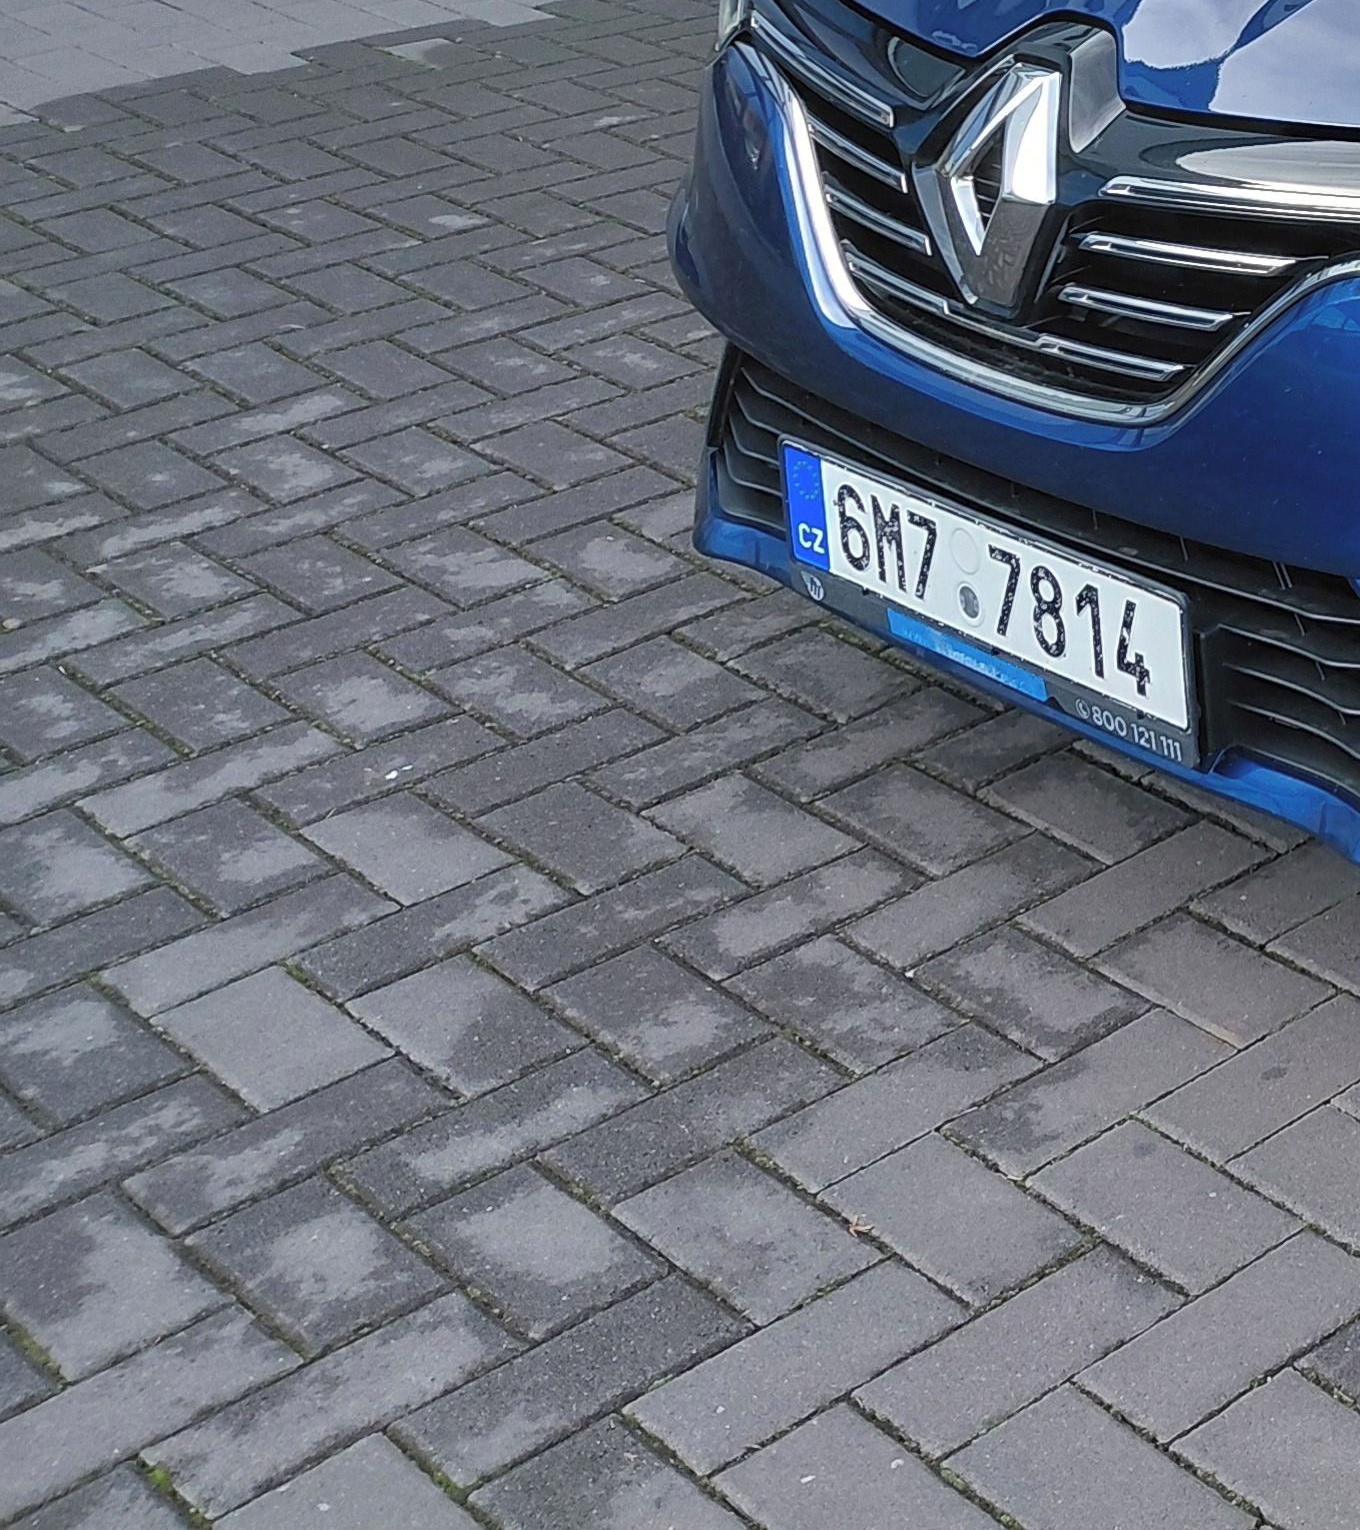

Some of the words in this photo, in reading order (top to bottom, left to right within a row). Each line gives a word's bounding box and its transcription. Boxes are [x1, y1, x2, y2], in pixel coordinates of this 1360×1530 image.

[798, 522, 826, 554] CZ
[837, 484, 938, 600] 6M7
[988, 544, 1152, 696] 7814
[1091, 706, 1127, 737] 800
[1130, 723, 1157, 751] 121
[1160, 736, 1182, 762] 111
